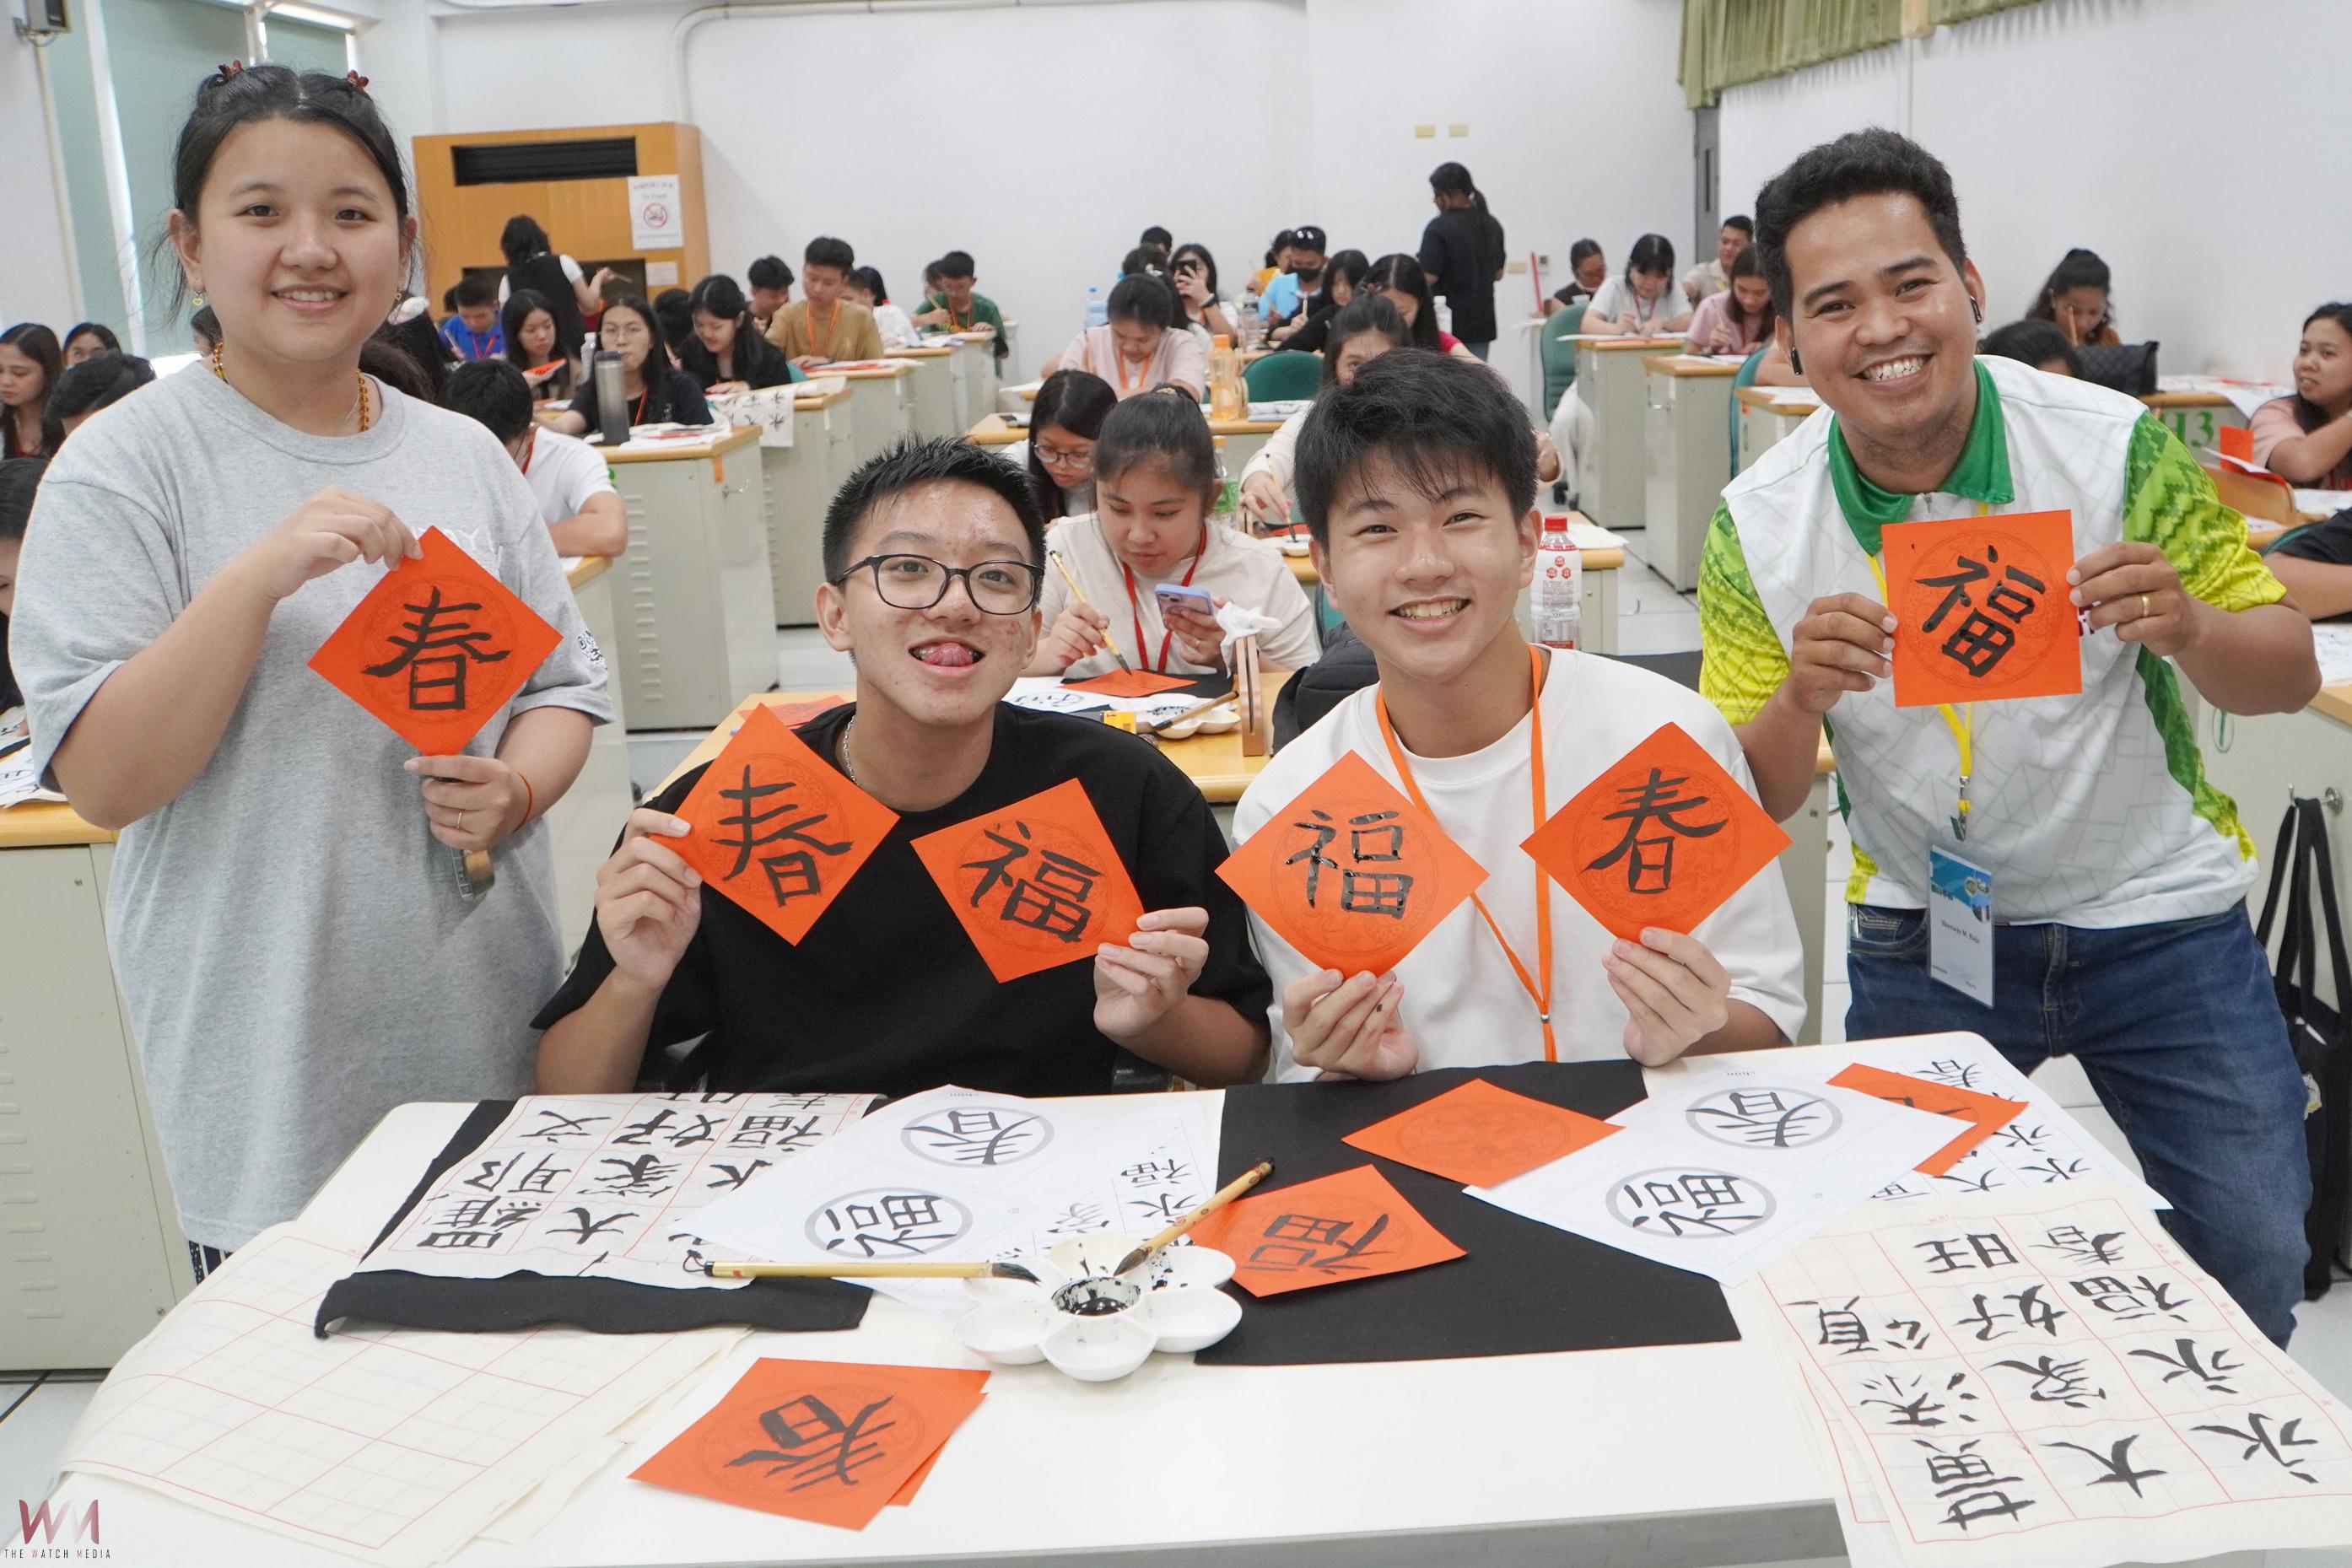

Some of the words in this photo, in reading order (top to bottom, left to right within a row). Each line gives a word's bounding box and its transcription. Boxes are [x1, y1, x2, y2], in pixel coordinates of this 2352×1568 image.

[361, 585, 511, 711] 春
[1915, 543, 2047, 678] 福
[710, 764, 853, 908] 春
[960, 821, 1104, 943] 福
[1285, 809, 1413, 919] 福
[1581, 767, 1729, 894] 春
[903, 1111, 1040, 1165] 春
[1686, 1091, 1825, 1147] 春
[825, 1195, 957, 1257] 福
[1243, 1214, 1395, 1274] 福
[1624, 1173, 1763, 1236] 福
[723, 1393, 896, 1493] 春
